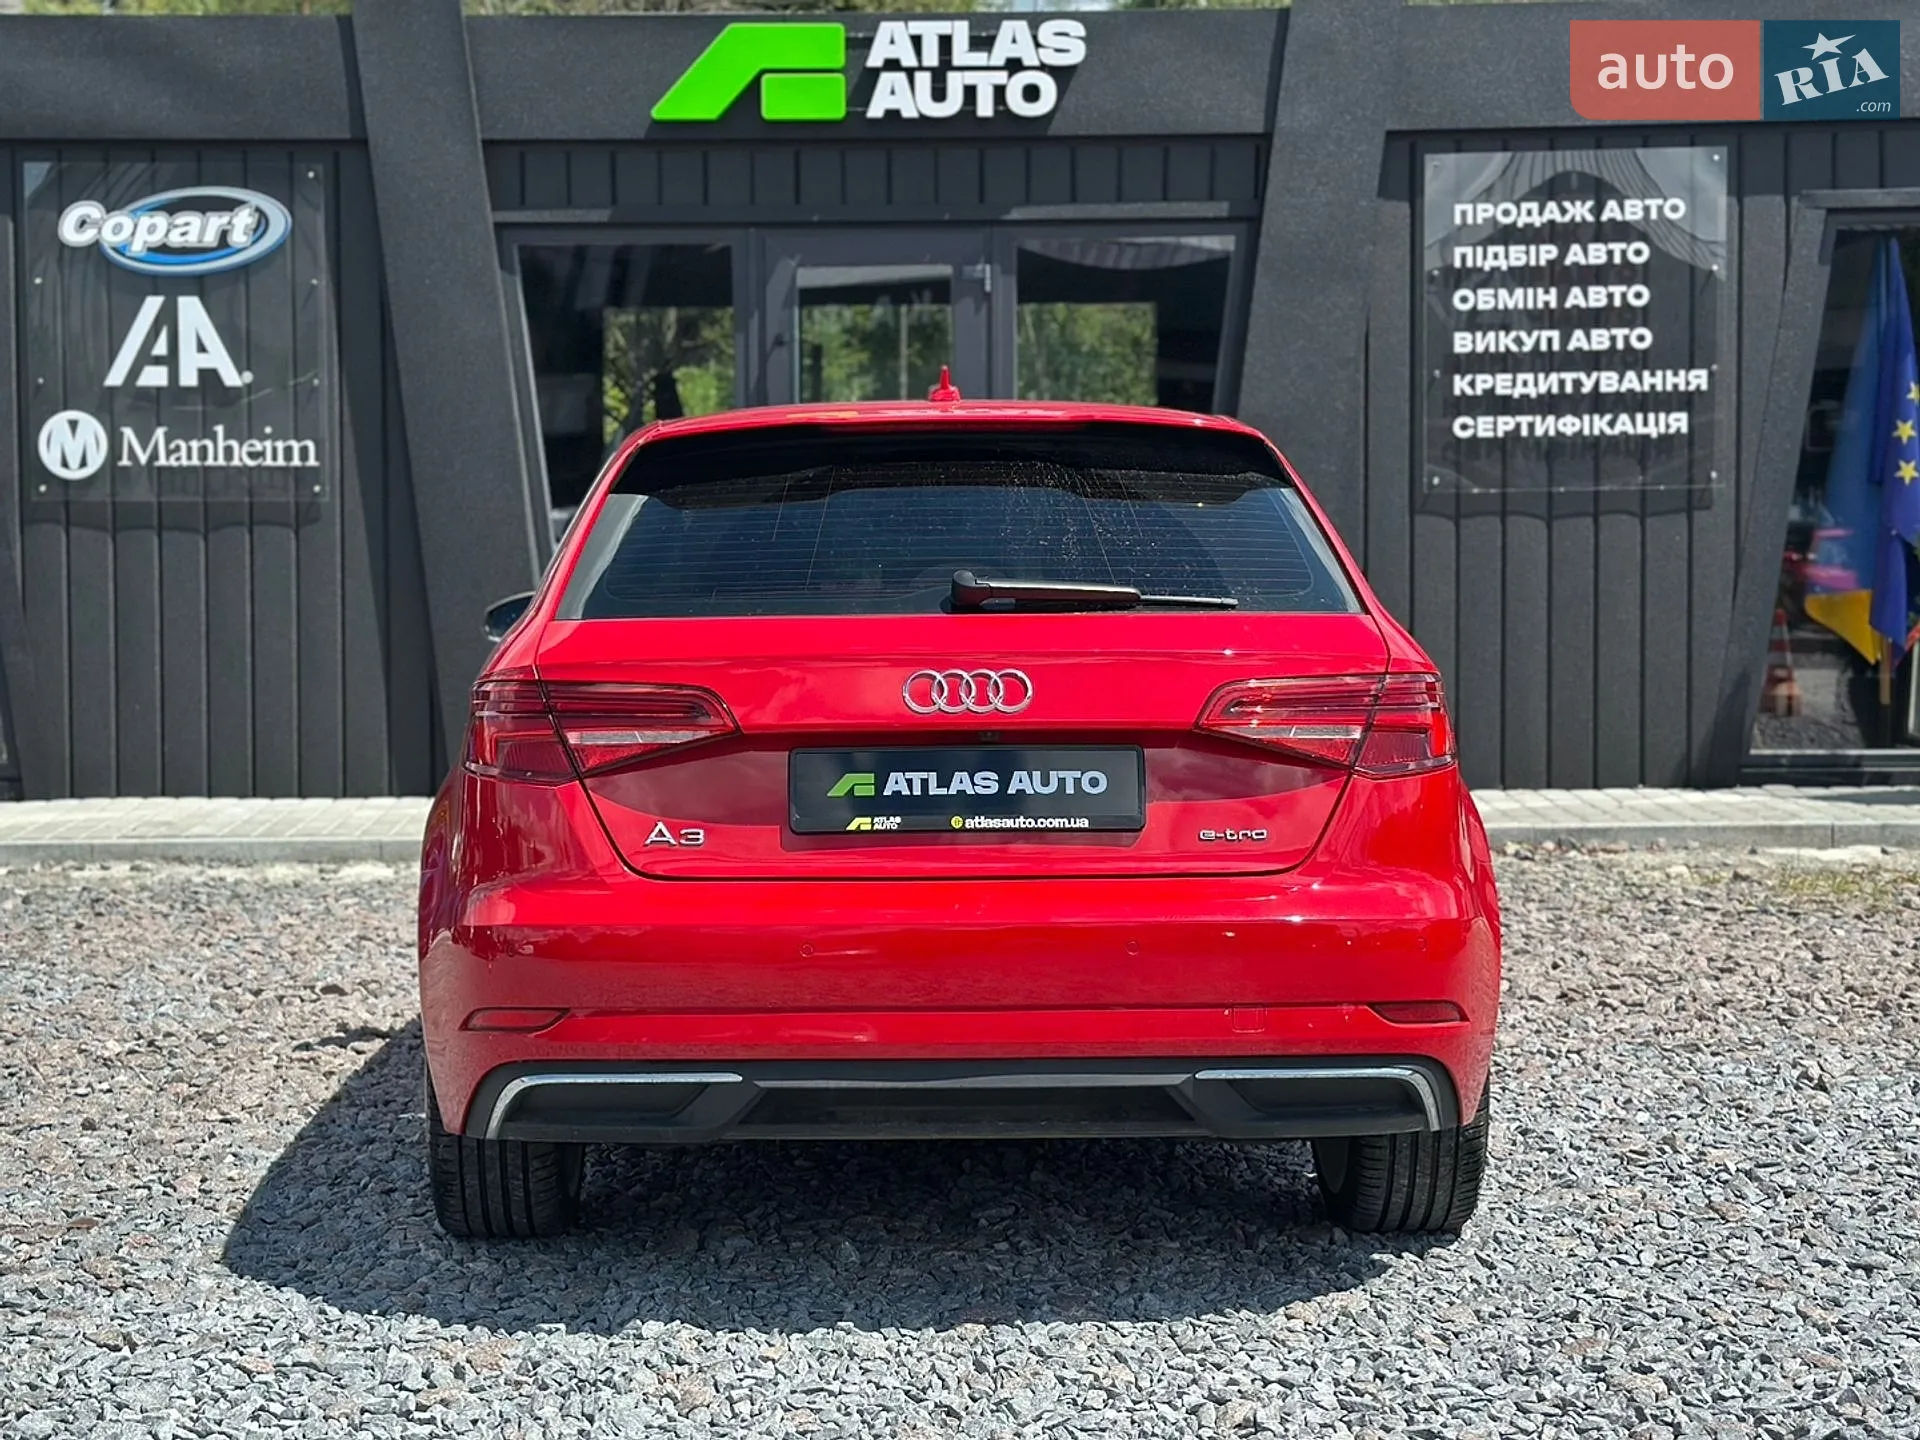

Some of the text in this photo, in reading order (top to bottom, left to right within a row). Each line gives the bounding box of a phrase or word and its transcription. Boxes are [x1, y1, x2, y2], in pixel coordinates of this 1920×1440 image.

[865, 20, 1087, 68] ATLAS
[865, 70, 1058, 119] AUTO
[1453, 198, 1687, 227] ПРОДАЖ АВТО
[58, 201, 259, 256] Copart
[1453, 242, 1650, 271] ПІДБІР АВТО
[1452, 285, 1650, 311] ОБМІН АВТО
[1453, 327, 1653, 354] ВИКУП АВТО
[1453, 369, 1709, 399] КРЕДИТУВАННЯ
[1452, 412, 1689, 439] СЕРТИФІКАЦІЯ
[117, 425, 320, 468] Manheim
[883, 770, 1108, 796] ATLAS AUTO
[643, 820, 705, 847] A3
[873, 822, 898, 830] AUTO
[965, 815, 1089, 829] atlasauto.com.ua
